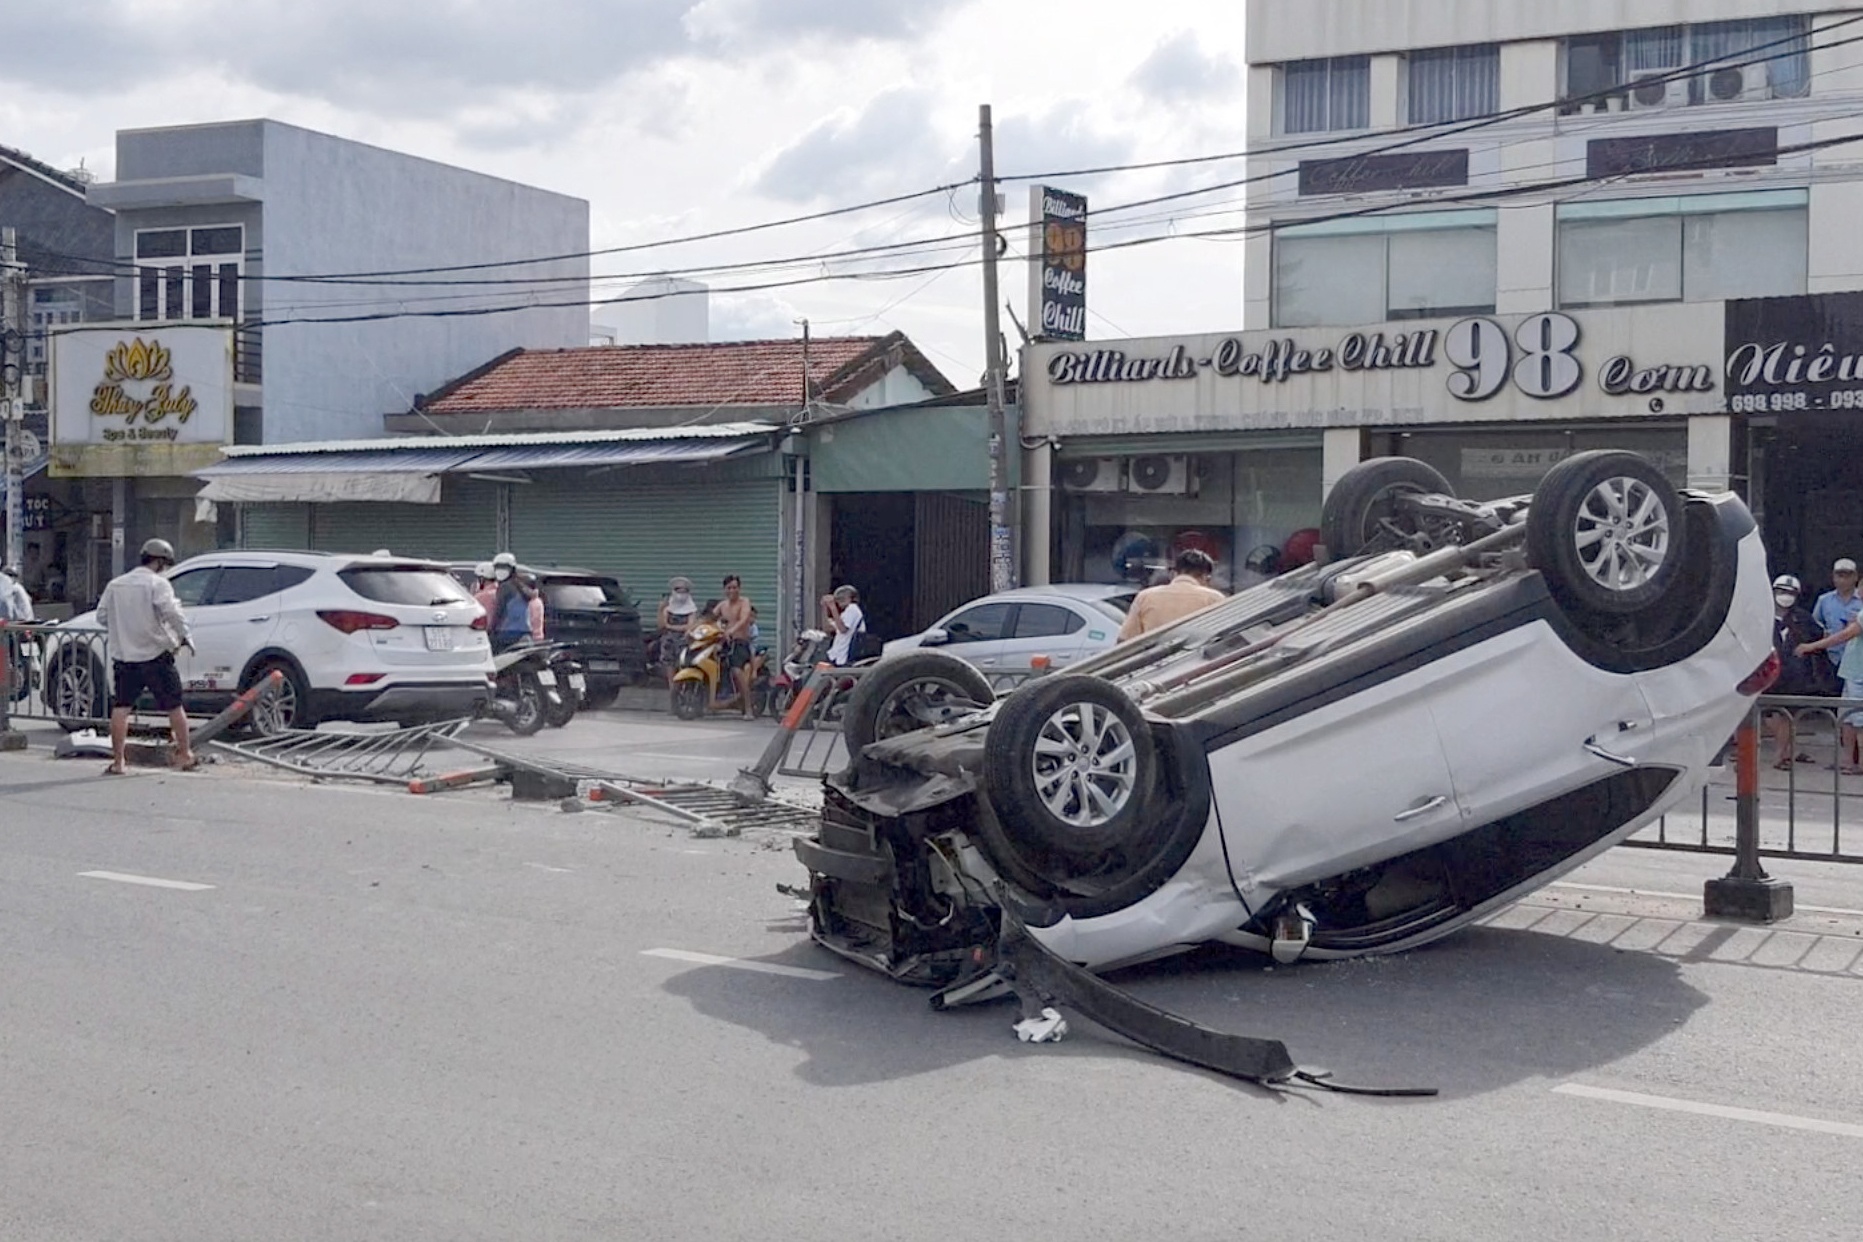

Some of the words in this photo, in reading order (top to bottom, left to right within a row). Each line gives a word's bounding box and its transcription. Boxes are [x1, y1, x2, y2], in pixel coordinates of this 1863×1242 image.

[1044, 267, 1084, 295] Coffee
[1044, 301, 1084, 333] Chill
[1336, 329, 1438, 371] Chill
[1445, 312, 1583, 400] 98
[1598, 355, 1714, 395] Cơm
[1732, 395, 1766, 412] 698
[1770, 392, 1806, 410] 998
